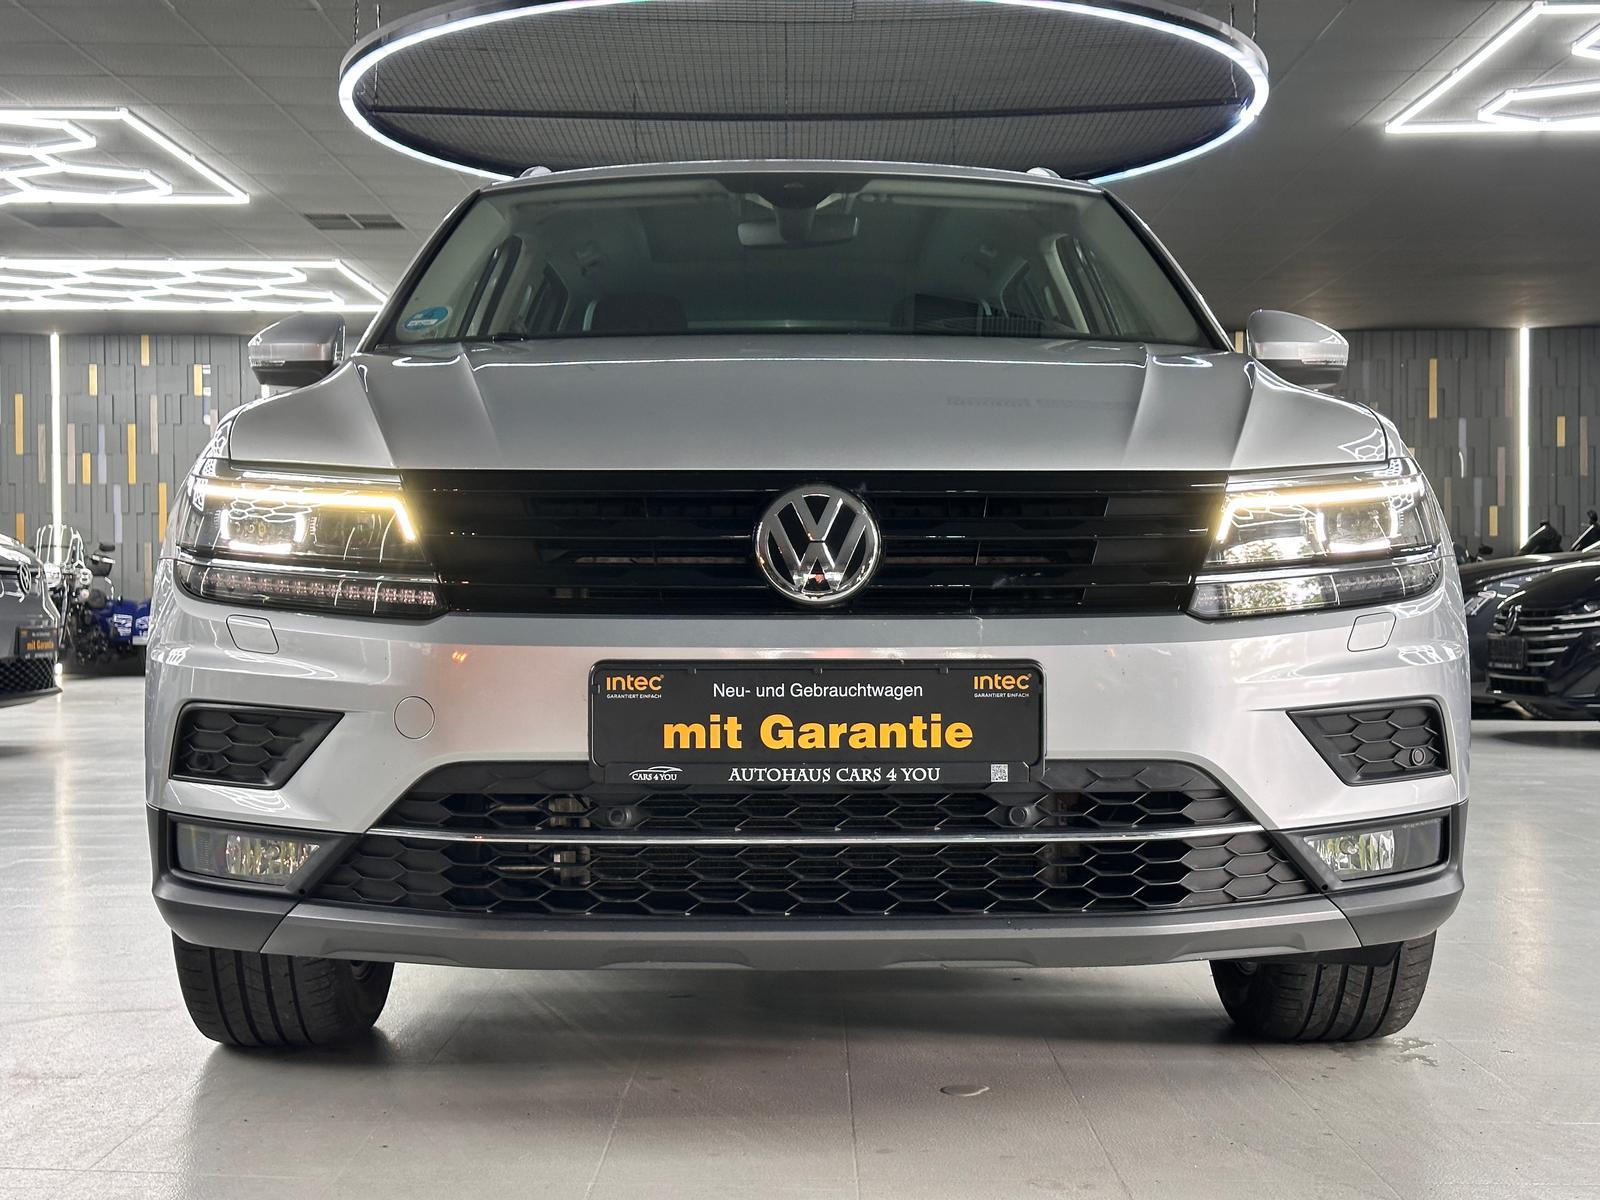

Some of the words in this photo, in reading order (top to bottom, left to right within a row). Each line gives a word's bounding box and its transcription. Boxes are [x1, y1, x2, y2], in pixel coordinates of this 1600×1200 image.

[606, 674, 662, 691] intec
[973, 673, 1030, 690] intec
[713, 683, 751, 697] Neu-
[756, 683, 785, 697] und
[790, 683, 923, 700] Gebrauchtwagen
[663, 714, 742, 749] mit
[760, 713, 973, 750] Garantie
[631, 773, 653, 781] CARS
[653, 773, 659, 781] 4
[659, 773, 678, 781] YOU
[728, 767, 831, 783] AUTOHAUS
[836, 767, 882, 783] CARS
[886, 767, 897, 782] 4
[900, 767, 941, 782] YOU
